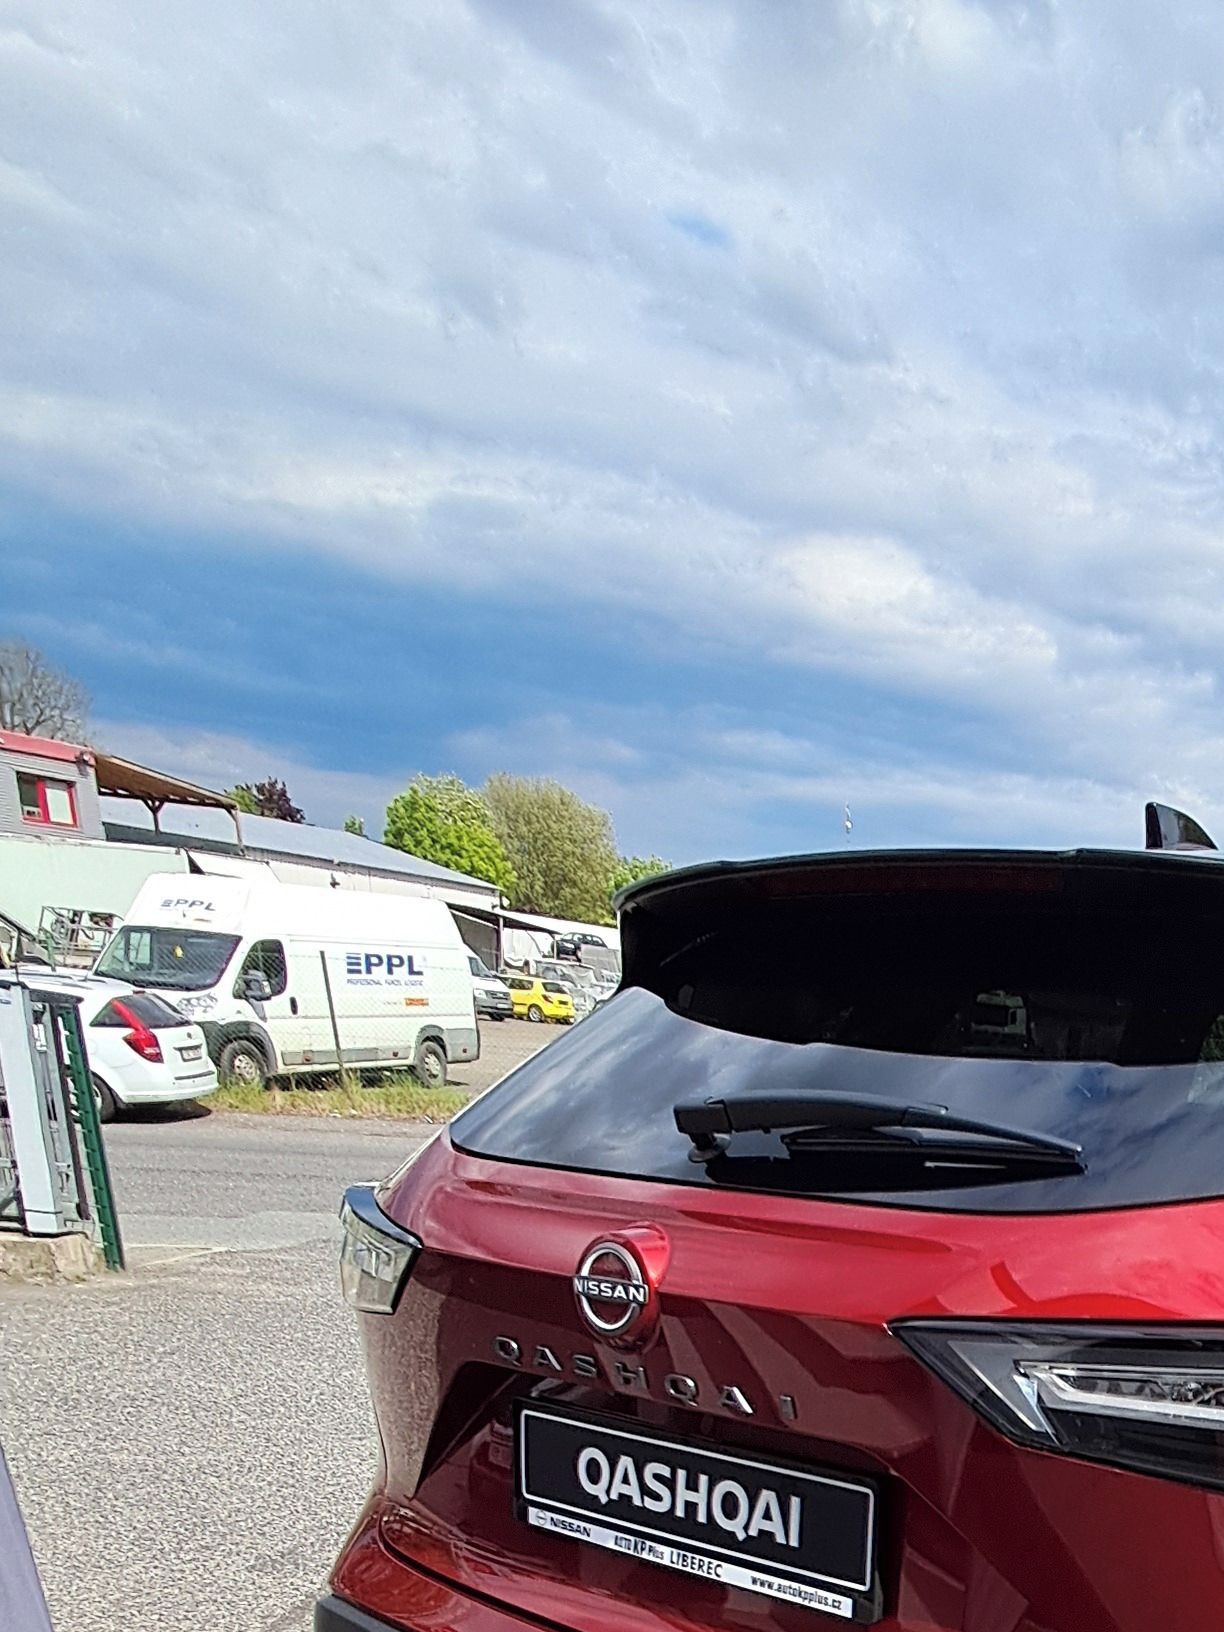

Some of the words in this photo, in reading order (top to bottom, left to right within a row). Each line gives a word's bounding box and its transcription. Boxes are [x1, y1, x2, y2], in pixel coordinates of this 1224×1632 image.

[574, 1278, 646, 1302] NISSAN
[495, 1335, 797, 1421] QASHQAI
[577, 1446, 801, 1548] QASHQAI
[549, 1516, 592, 1538] NISSAN
[633, 1539, 647, 1556] KP
[669, 1549, 724, 1578] LIBEREC
[750, 1575, 842, 1610] www.autokpplus.cz
